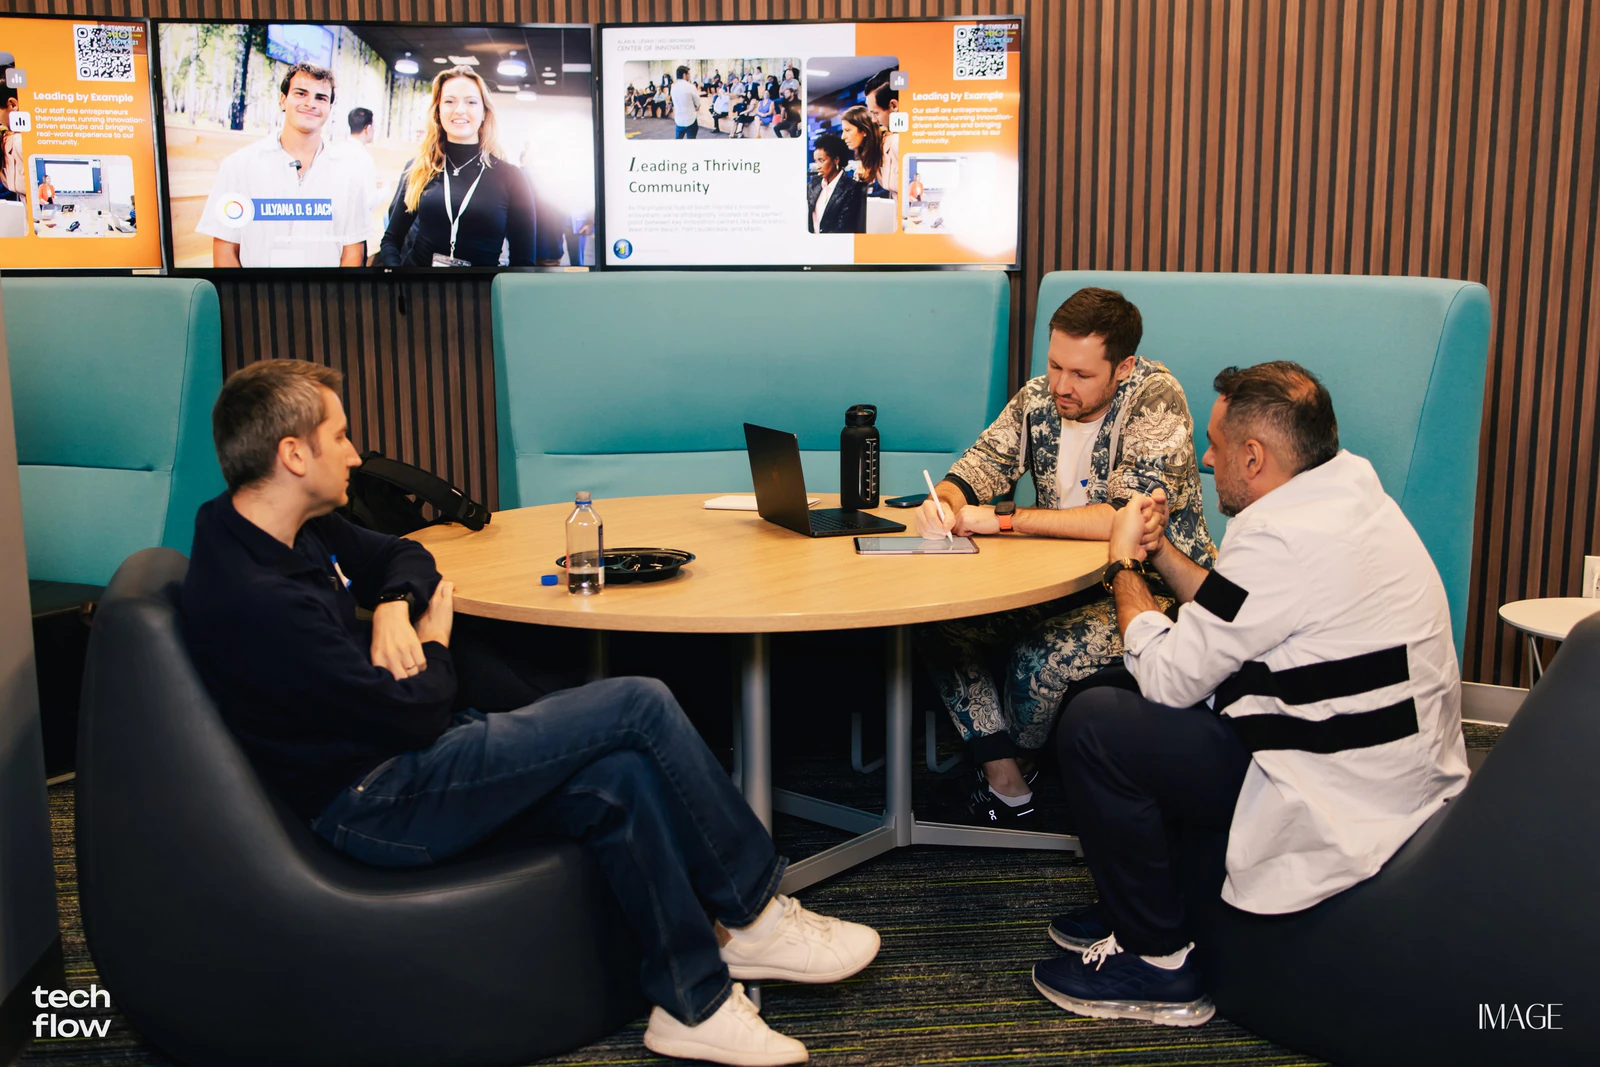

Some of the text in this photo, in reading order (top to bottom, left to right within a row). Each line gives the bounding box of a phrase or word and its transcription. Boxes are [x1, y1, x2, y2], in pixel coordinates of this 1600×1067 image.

[34, 92, 133, 104] Leading by Example
[912, 91, 1003, 102] Leading by Example
[692, 162, 699, 172] a
[704, 159, 760, 173] Thriving
[629, 180, 710, 195] Community
[261, 203, 294, 216] LILYANA
[296, 203, 304, 216] D.
[306, 203, 312, 216] &
